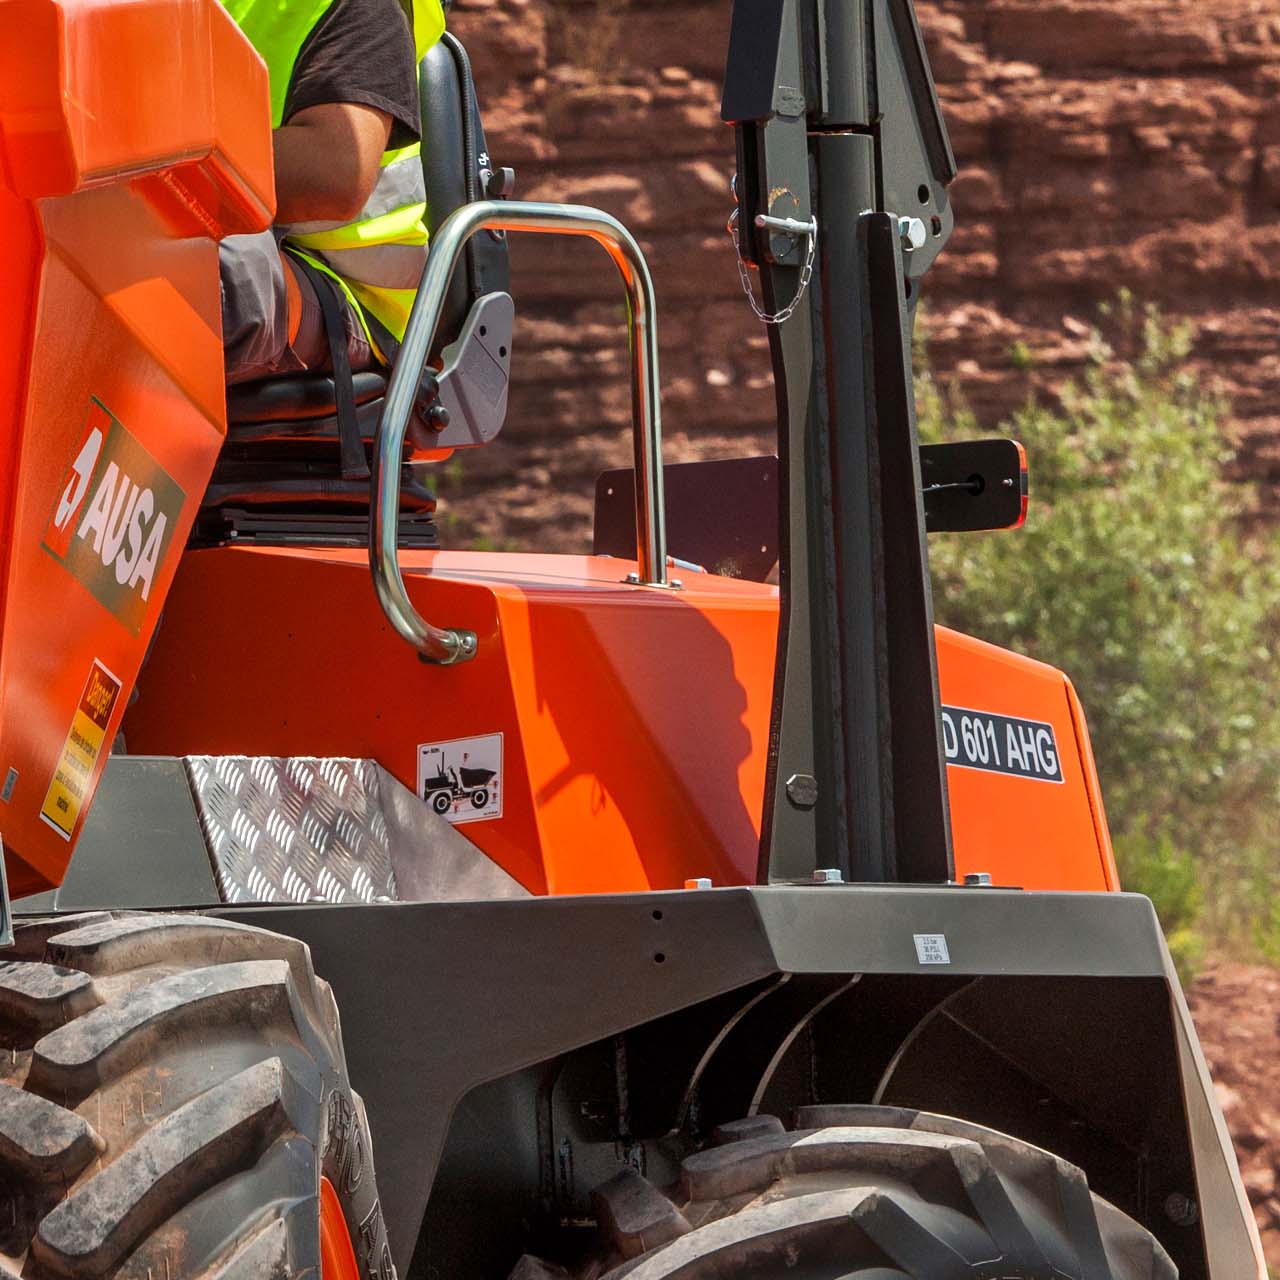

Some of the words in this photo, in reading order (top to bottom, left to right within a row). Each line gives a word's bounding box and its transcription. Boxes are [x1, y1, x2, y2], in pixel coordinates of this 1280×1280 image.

[78, 461, 167, 602] AUSA
[961, 715, 1001, 766] 601
[1006, 723, 1058, 776] AHG
